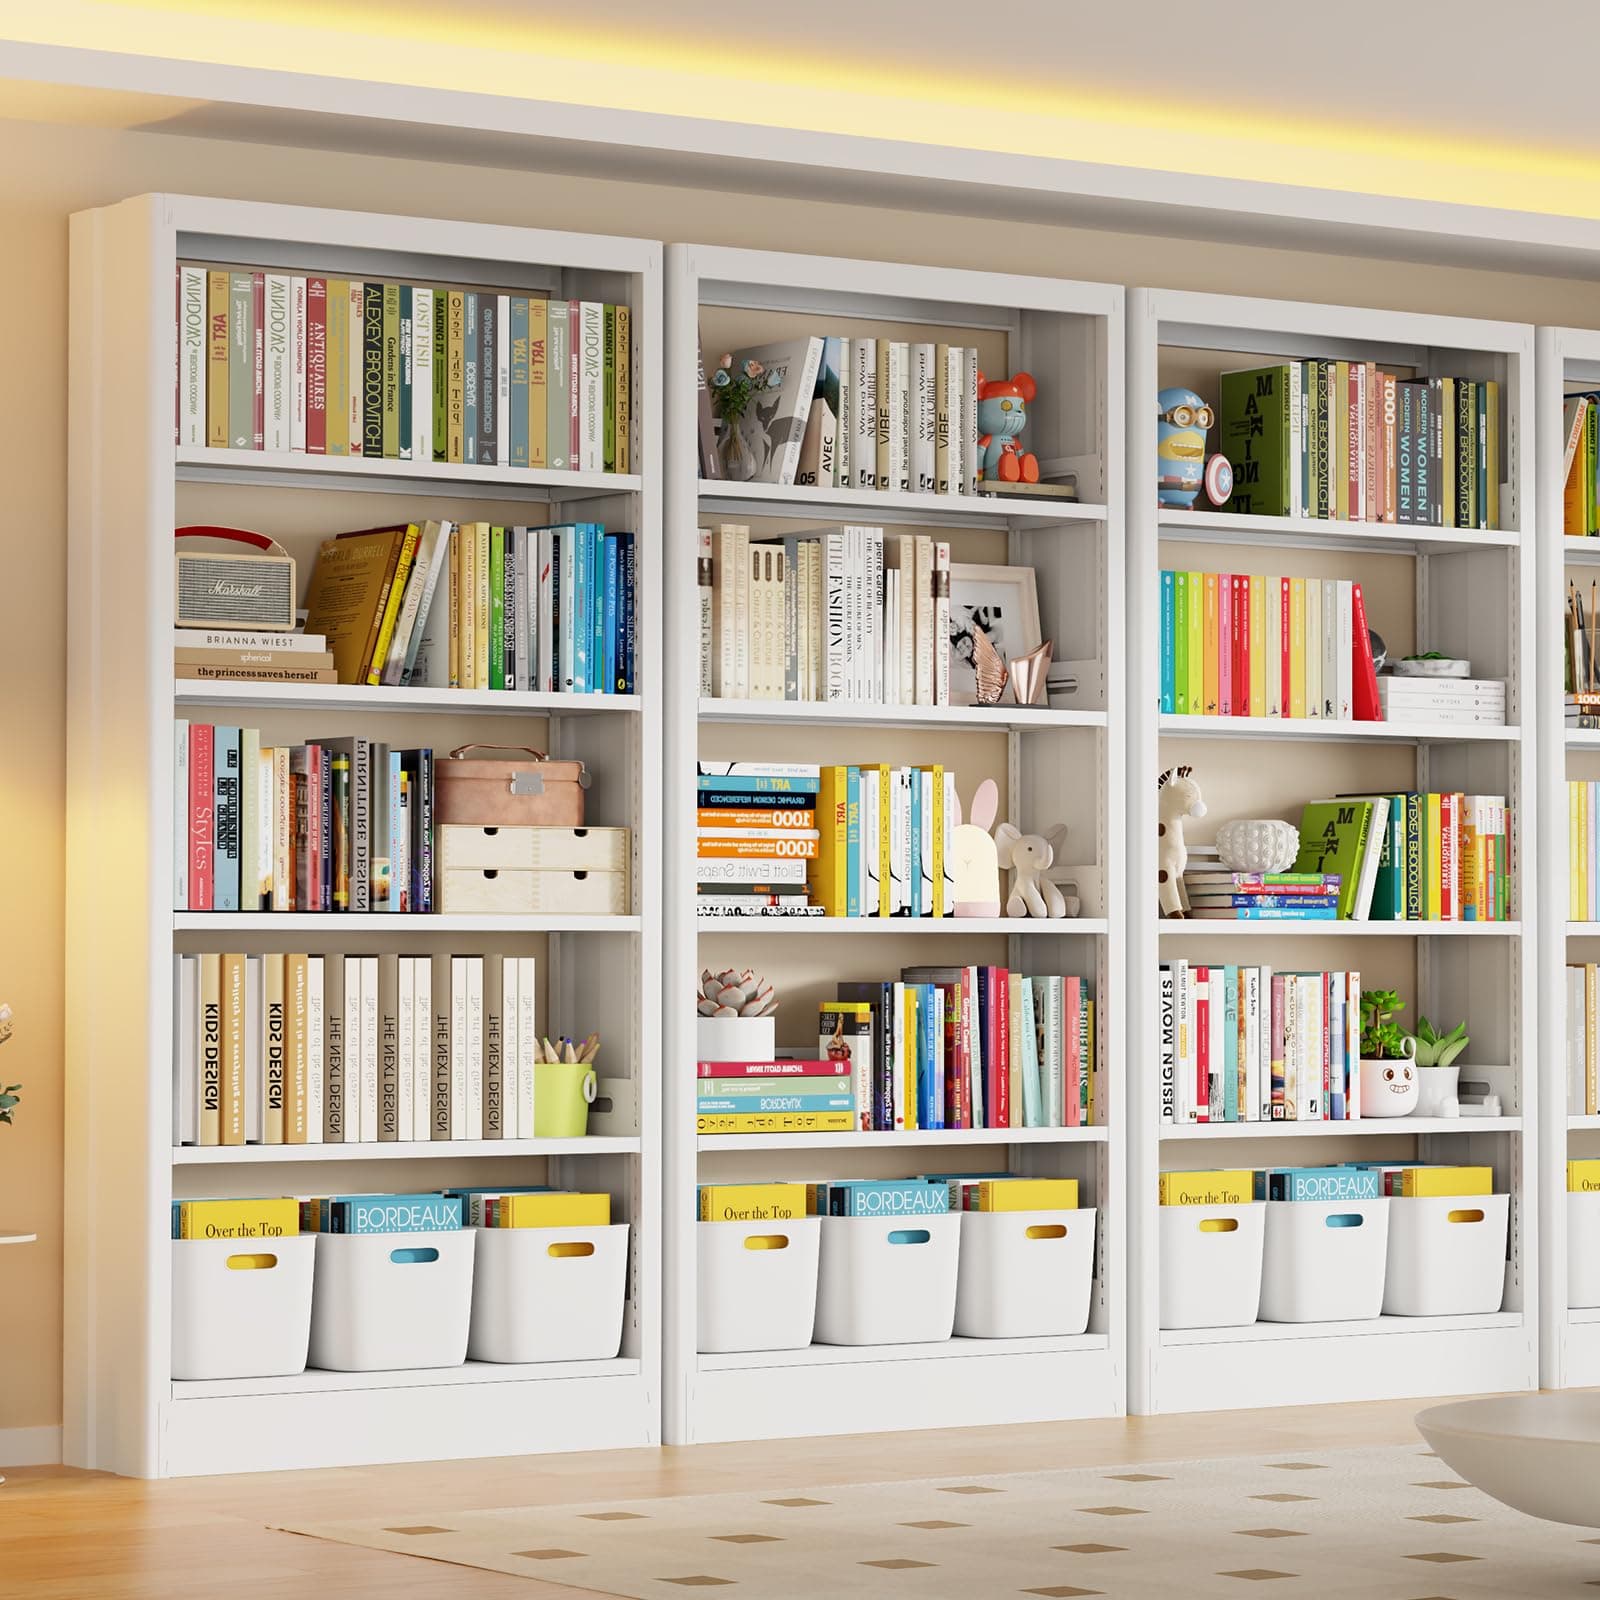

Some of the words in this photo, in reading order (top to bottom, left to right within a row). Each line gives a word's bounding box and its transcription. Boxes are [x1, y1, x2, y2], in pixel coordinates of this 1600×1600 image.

[366, 287, 381, 346] ALEXEY
[417, 293, 430, 331] LOST
[435, 298, 445, 341] MAKING
[386, 337, 397, 371] Gardens
[417, 335, 430, 367] FISH
[435, 343, 445, 355] IT
[312, 322, 325, 411] ANTIQUAIRES
[388, 374, 397, 385] in
[365, 350, 381, 448] BRODOVITCH
[387, 388, 397, 413] France
[1460, 380, 1468, 432] ALEXEY
[879, 408, 890, 444] VIBE
[939, 413, 949, 449] VIBE
[822, 436, 833, 472] AVEC
[800, 471, 816, 485] 05
[1400, 435, 1410, 510] WOMEN
[1417, 437, 1427, 511] WOMEN
[1460, 435, 1468, 521] BRODOVITCH
[829, 537, 843, 571] THE
[875, 541, 883, 573] pierre
[208, 579, 263, 597] Marshall
[875, 575, 883, 606] cardin
[829, 575, 843, 647] FASHION
[207, 636, 257, 646] BRIANNA
[262, 637, 294, 648] WIEST
[240, 653, 272, 663] spherical
[198, 667, 215, 677] the
[215, 668, 257, 680] princess
[257, 671, 285, 679] saves
[285, 670, 320, 680] herself
[228, 750, 237, 768] LE
[218, 777, 227, 795] LE
[218, 805, 227, 849] GRAND
[228, 777, 237, 858] CORBUSIER
[192, 807, 212, 871] Styles
[1162, 979, 1173, 1045] MOVES
[1162, 1053, 1173, 1117] DESIGN
[856, 1189, 946, 1212] BORDEAUX
[1180, 1191, 1203, 1205] Over
[1204, 1191, 1219, 1204] the
[1221, 1190, 1240, 1204] Top
[1296, 1176, 1376, 1197] BORDEAUX
[1582, 1178, 1600, 1191] Ove
[357, 1205, 459, 1229] BORDEAUX
[724, 1206, 750, 1220] Over
[752, 1206, 769, 1219] the
[771, 1206, 792, 1220] Top
[205, 1223, 235, 1239] Over
[237, 1222, 256, 1238] the
[259, 1222, 283, 1238] Top
